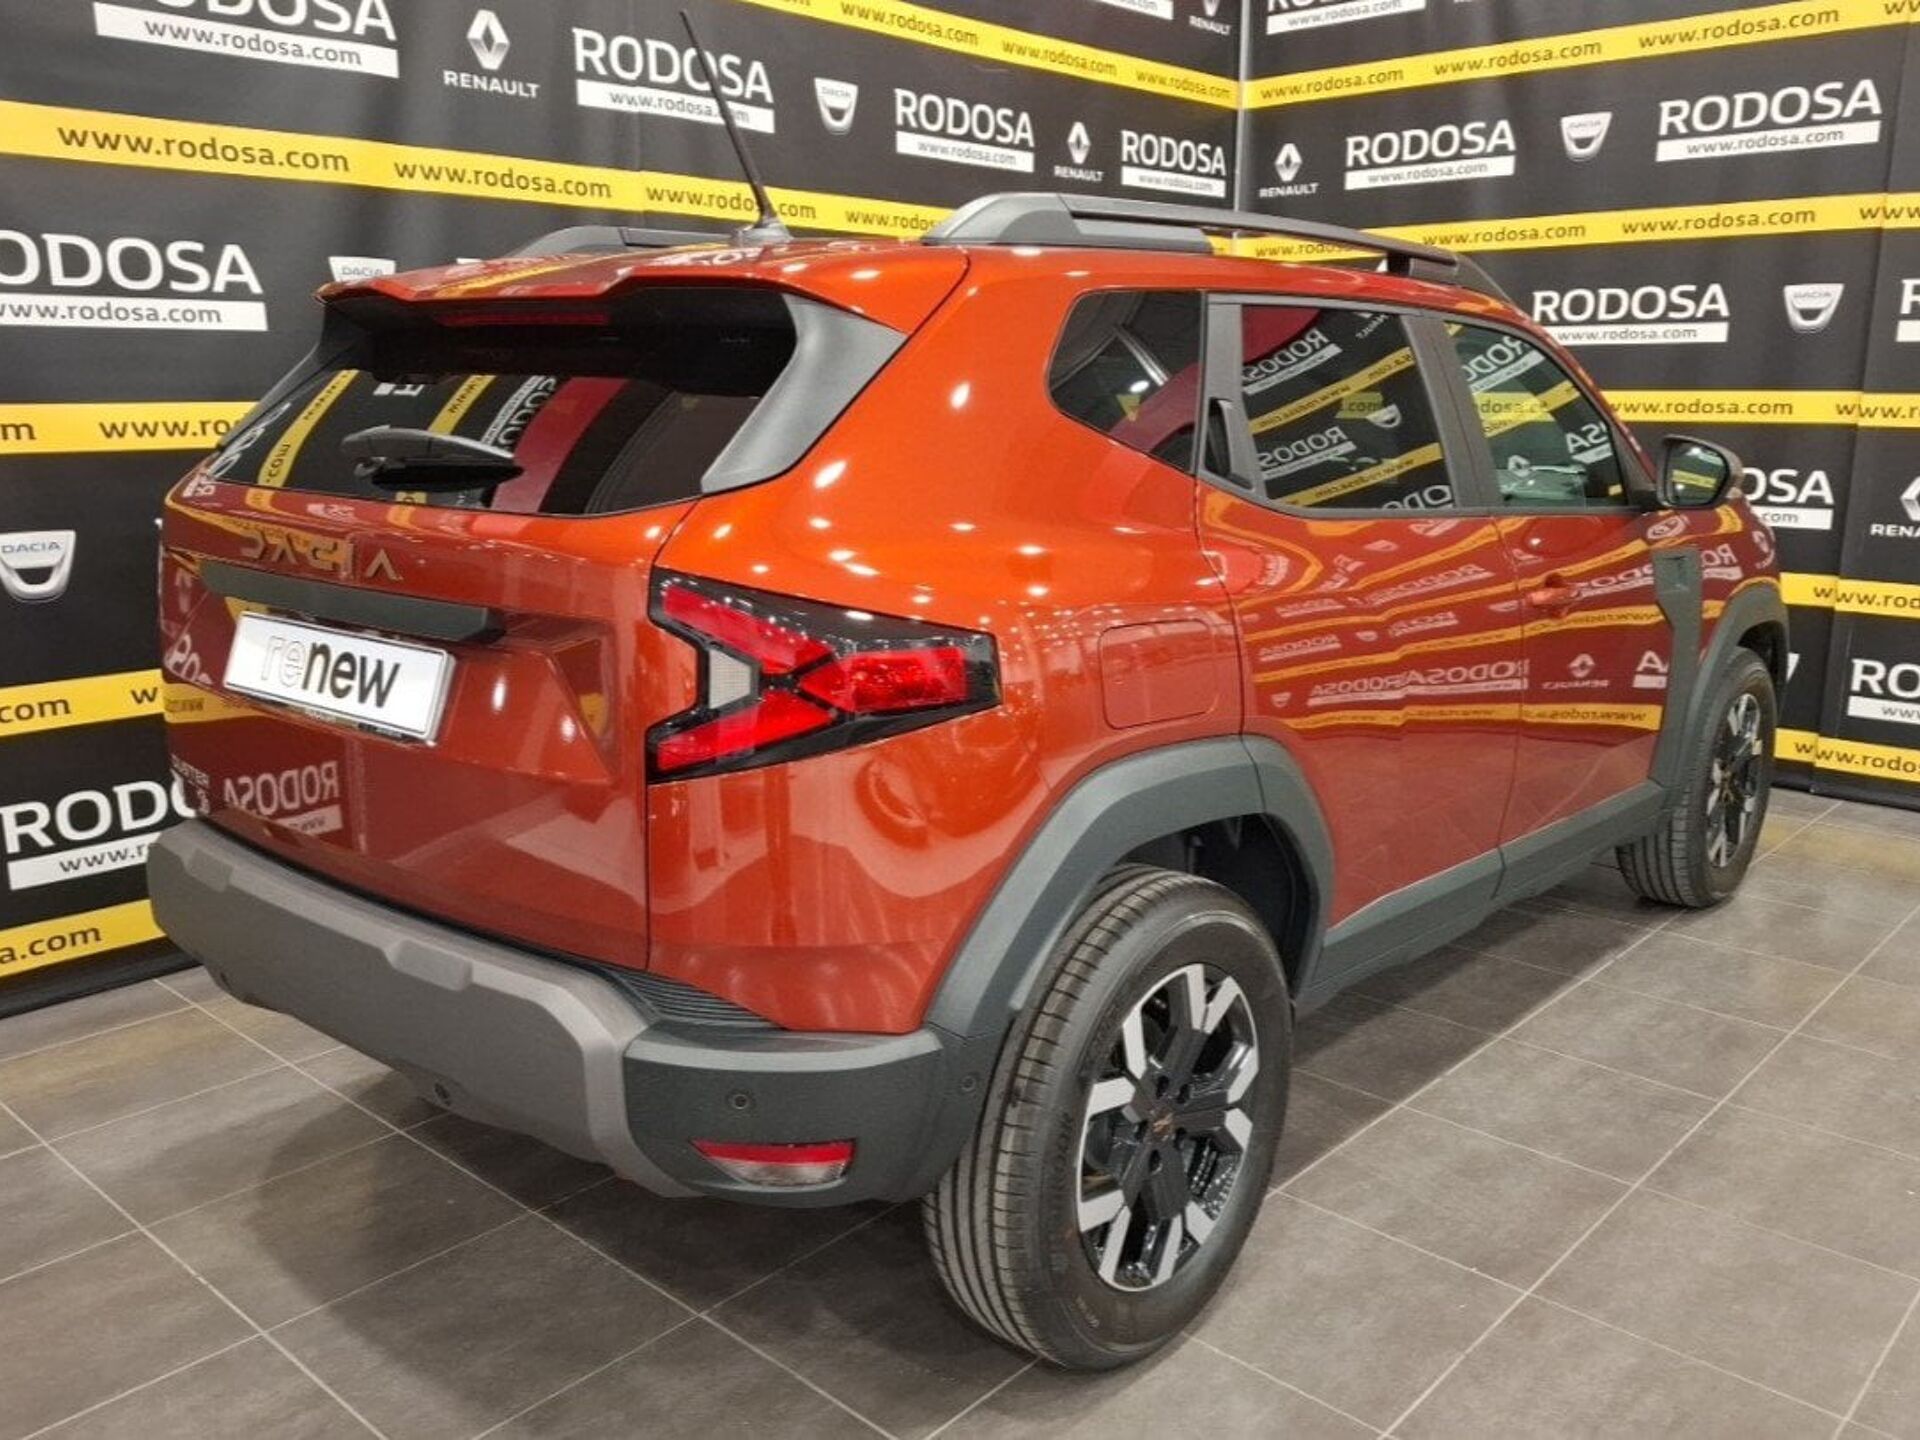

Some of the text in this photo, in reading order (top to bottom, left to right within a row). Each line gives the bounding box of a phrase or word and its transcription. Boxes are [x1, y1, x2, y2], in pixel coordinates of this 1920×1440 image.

[145, 20, 362, 65] www.rodosa.com
[840, 2, 980, 46] www.rodosa.com
[1637, 9, 1841, 49] www.rodosa.com
[571, 27, 774, 103] RODOSA
[1000, 38, 1118, 77] www.rodosa.com
[1433, 40, 1602, 76] www.rodosa.com
[442, 70, 541, 99] RENAULT
[1259, 68, 1405, 100] www.rodosa.com
[894, 88, 1035, 148] RODOSA
[1657, 79, 1883, 136] RODOSA
[57, 125, 351, 172] www.rodosa.com
[1120, 129, 1227, 177] RODOSA
[1344, 119, 1517, 168] RODOSA
[1686, 129, 1844, 155] www.rodosa.com
[393, 160, 613, 199] www.rodosa.com
[1259, 182, 1319, 199] RENAULT
[1621, 208, 1816, 235] www.rodosa.com
[1532, 283, 1730, 323] RODOSA
[1556, 327, 1698, 342] www.rodosa.com
[260, 635, 401, 709] renew
